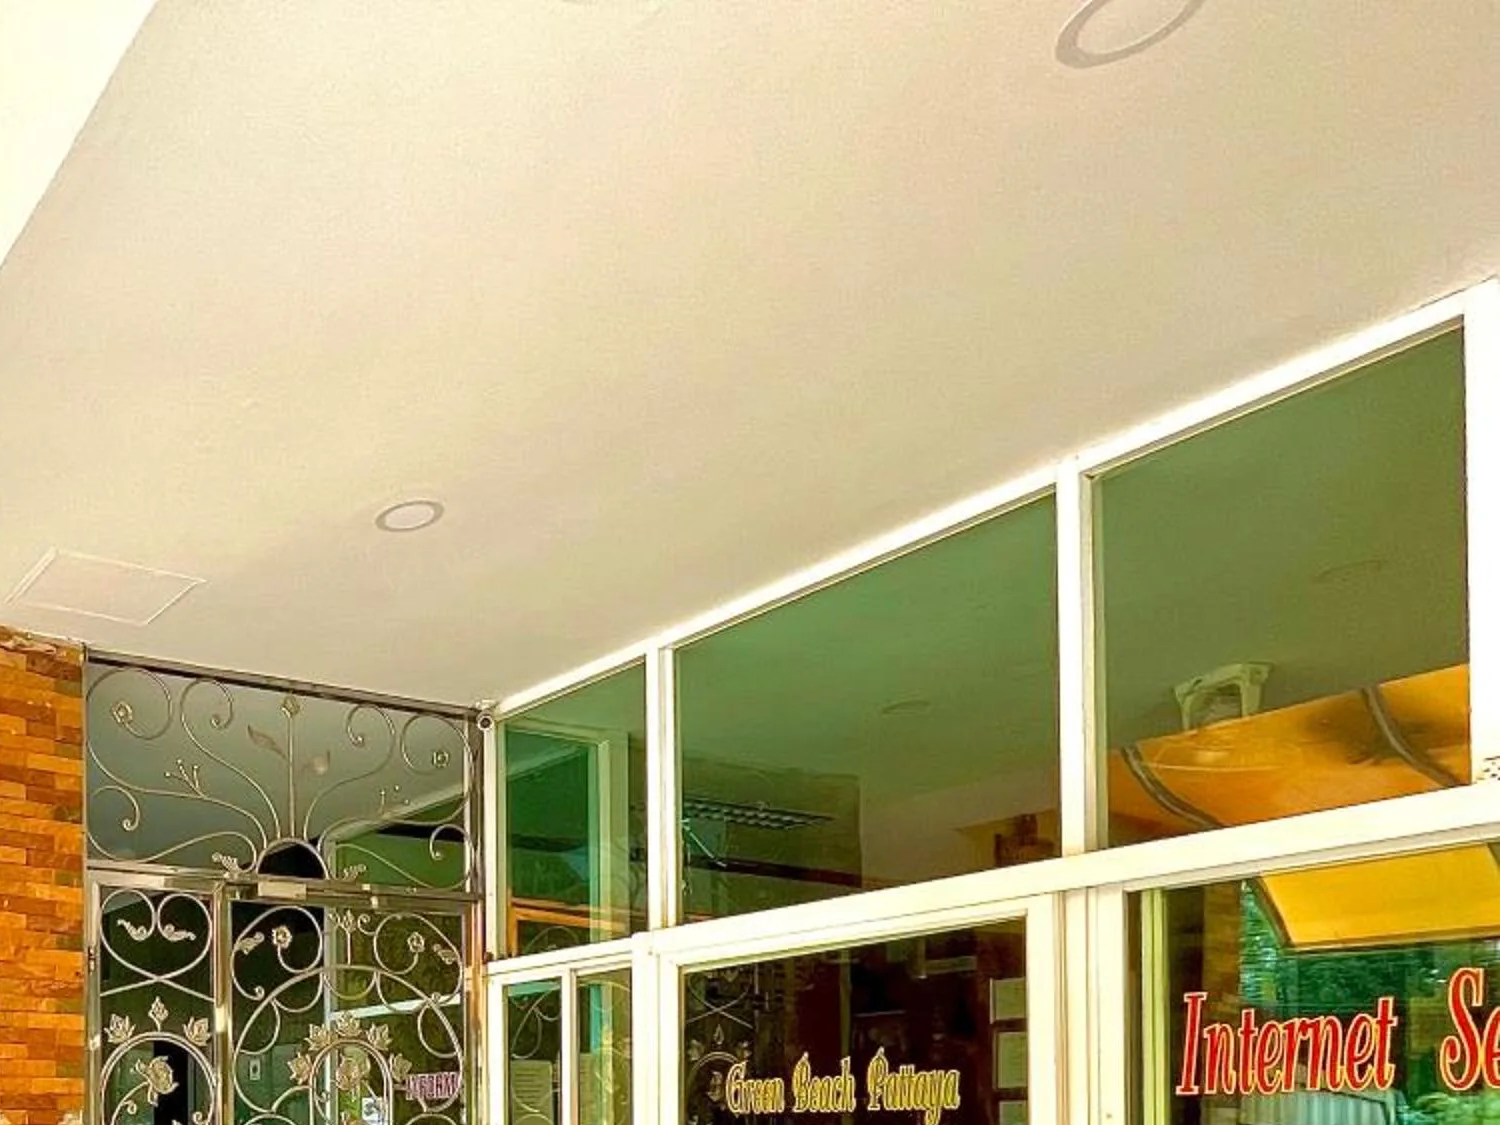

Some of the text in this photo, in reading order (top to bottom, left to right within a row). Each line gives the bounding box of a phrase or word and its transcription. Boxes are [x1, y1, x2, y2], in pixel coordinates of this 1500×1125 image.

[726, 1060, 785, 1117] Green
[793, 1052, 857, 1113] Beach
[1176, 992, 1398, 1095] Internet
